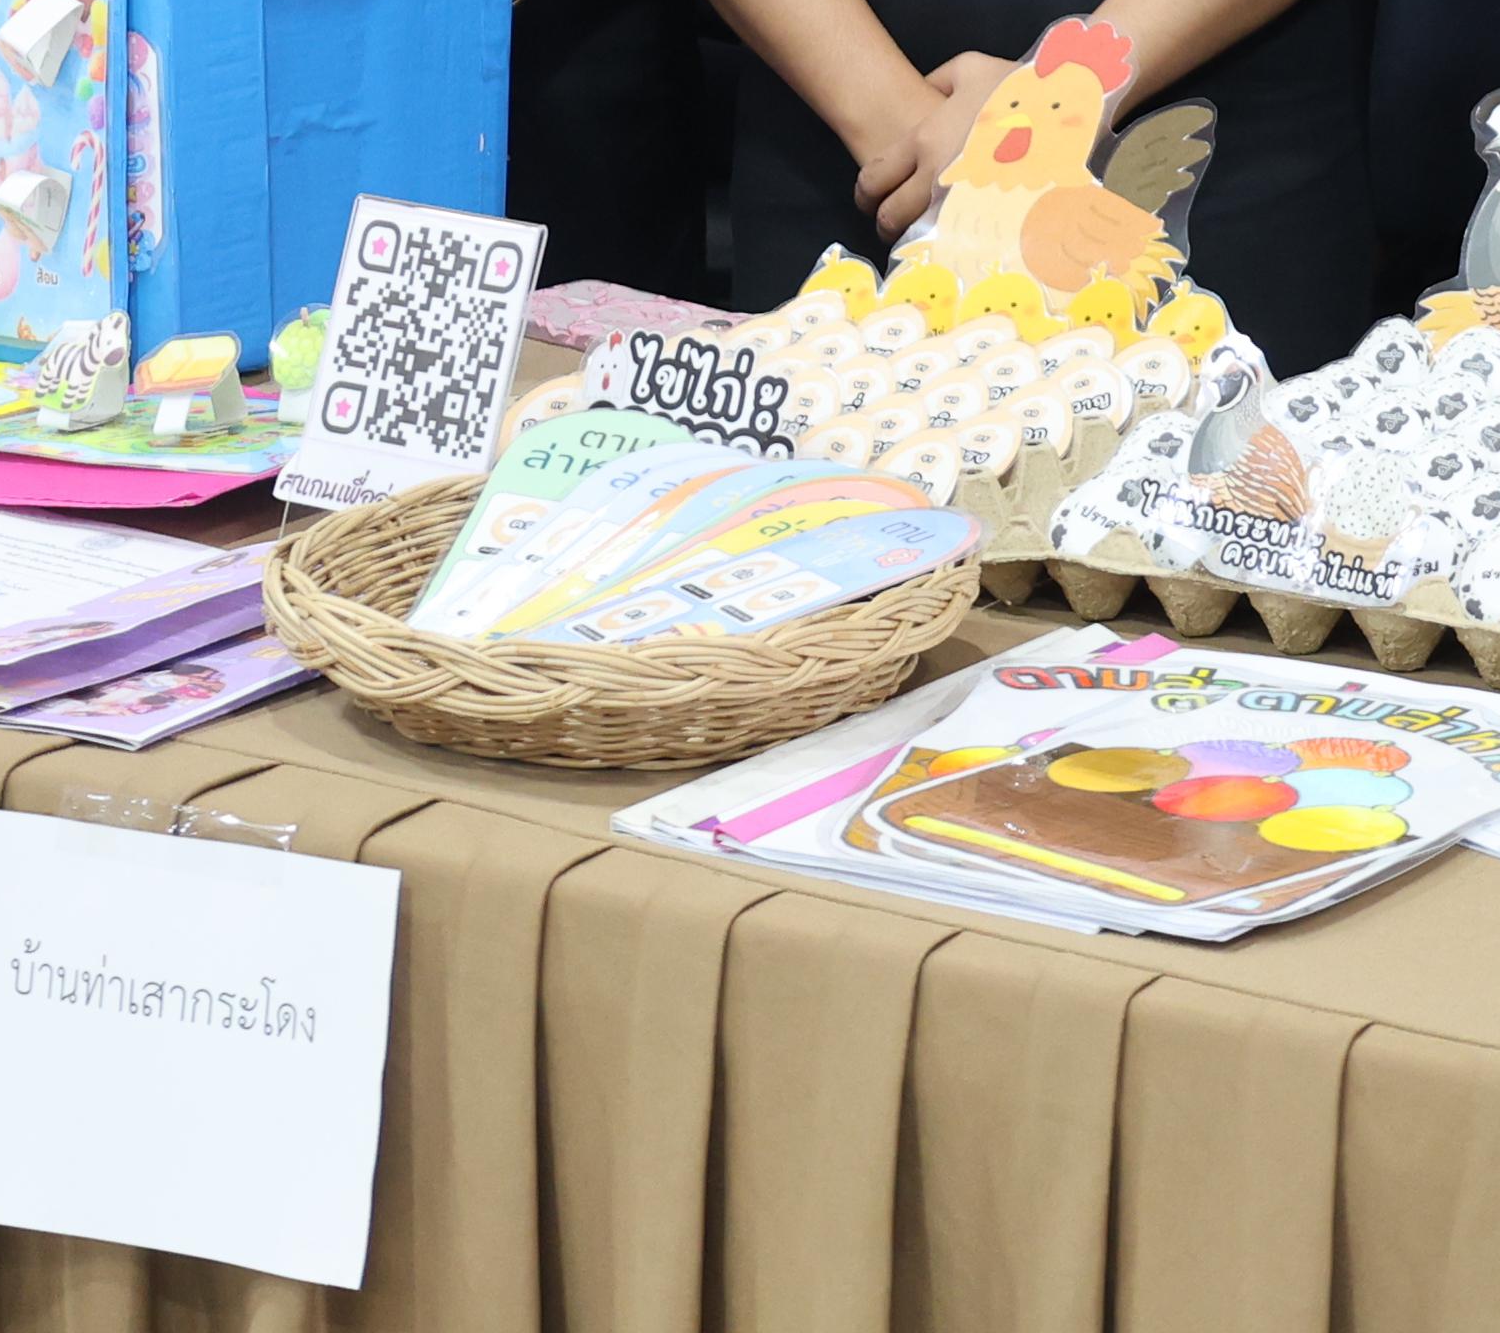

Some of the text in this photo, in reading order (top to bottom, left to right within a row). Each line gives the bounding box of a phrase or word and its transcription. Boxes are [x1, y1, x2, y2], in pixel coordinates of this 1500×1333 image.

[630, 331, 755, 421] ไข่ไก่
[10, 937, 317, 1044] บ้านท่าเสากระโดง
